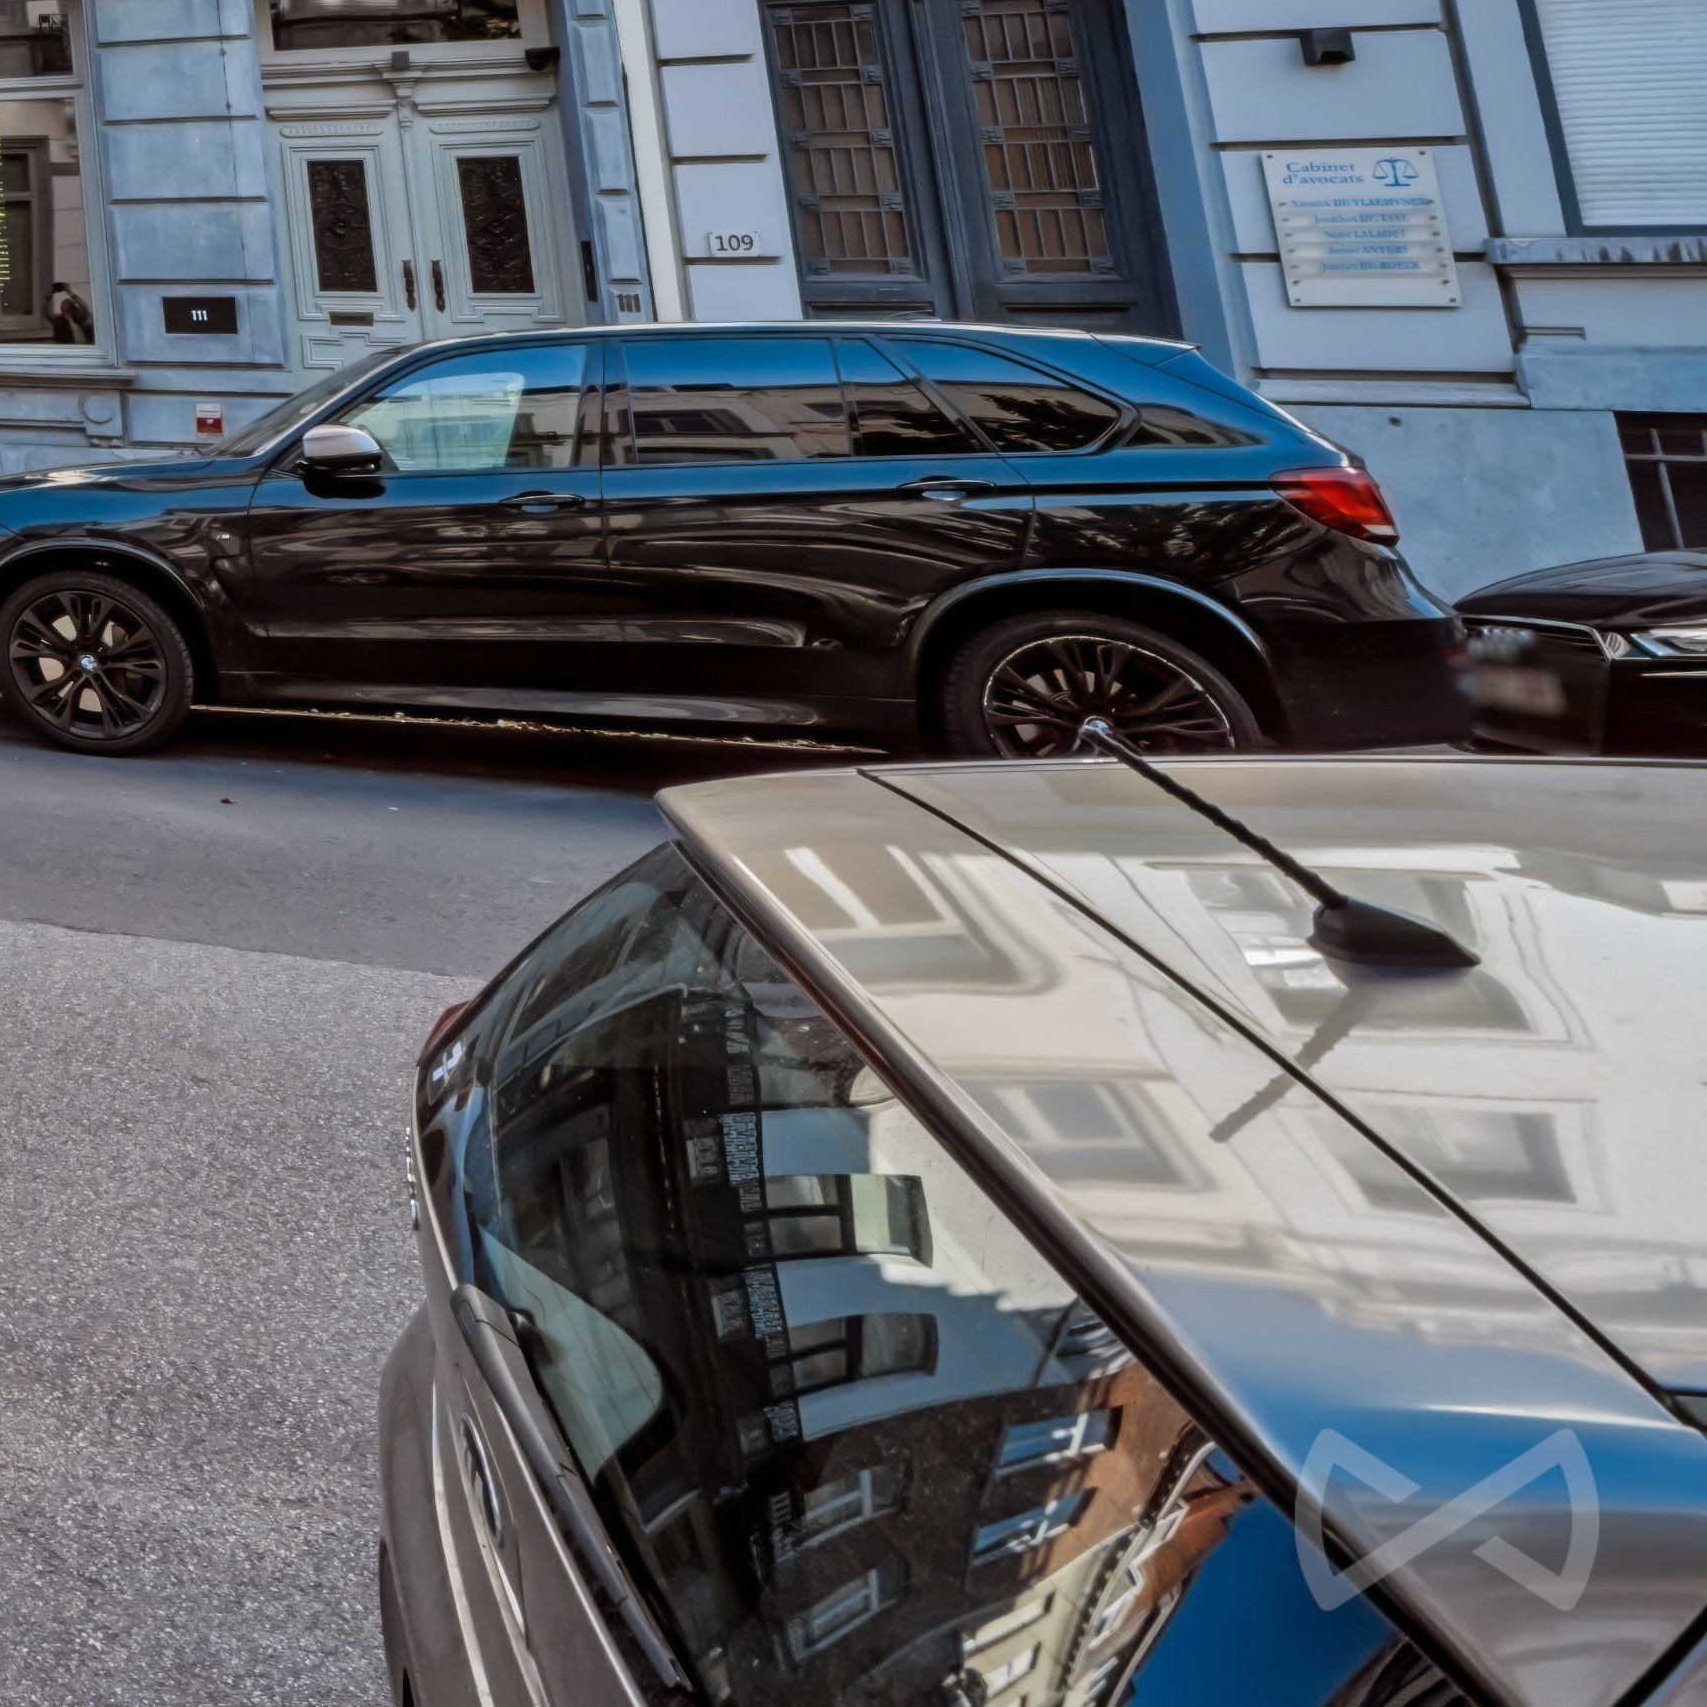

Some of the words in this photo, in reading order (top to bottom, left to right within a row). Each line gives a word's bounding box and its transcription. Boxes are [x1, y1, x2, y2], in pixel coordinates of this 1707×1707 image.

[1286, 161, 1356, 173] Cabinet
[1282, 174, 1364, 185] d'avocats
[715, 235, 754, 251] 109
[616, 293, 641, 312] 111
[191, 310, 208, 321] 111
